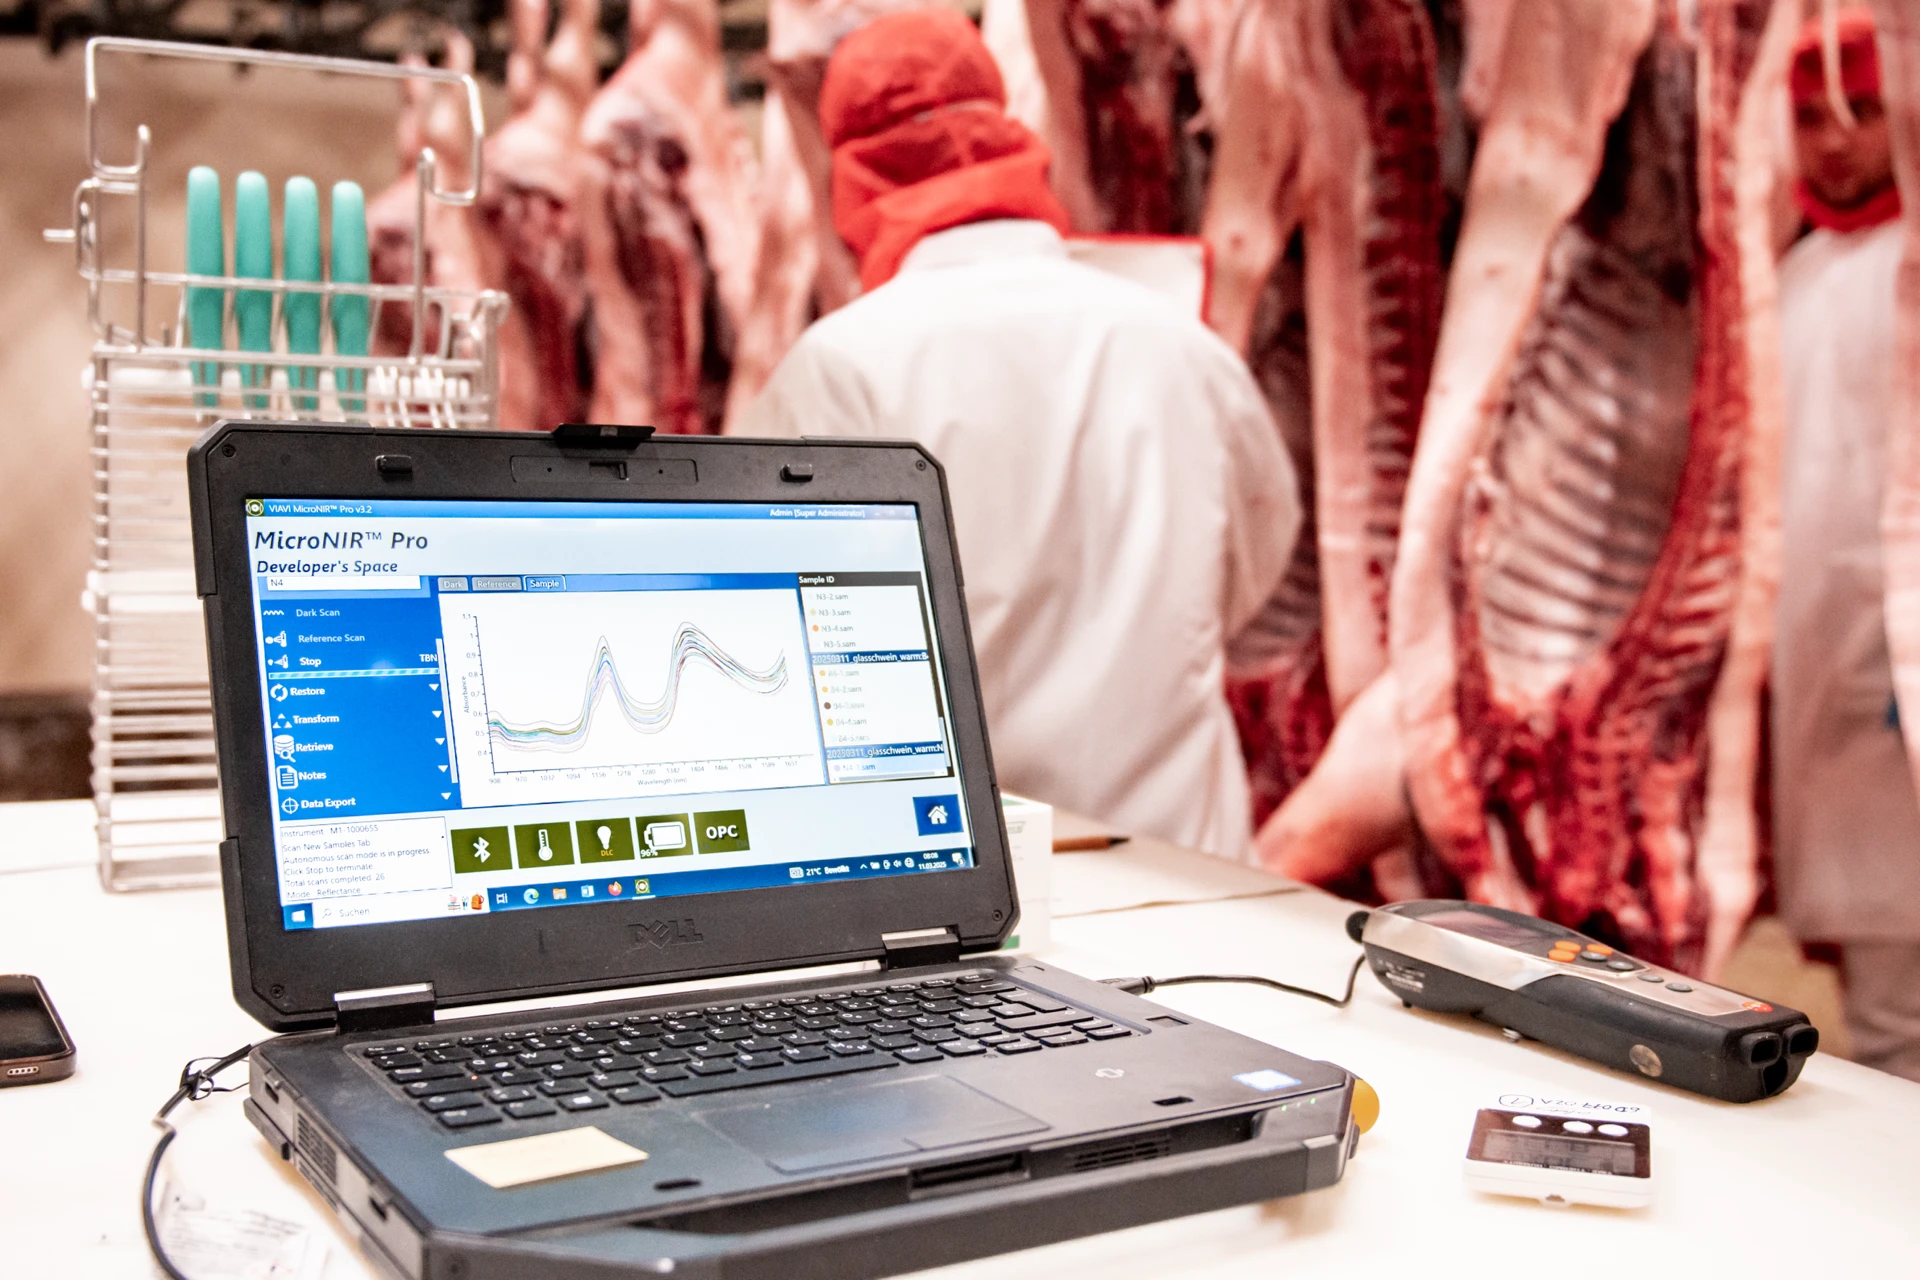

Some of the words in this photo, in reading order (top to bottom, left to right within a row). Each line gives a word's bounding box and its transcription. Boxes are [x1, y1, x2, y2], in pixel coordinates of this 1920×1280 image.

[269, 505, 291, 513] VIAVI
[340, 505, 354, 513] Pro
[356, 506, 373, 514] v3.2
[770, 509, 793, 517] Admin
[390, 531, 428, 550] Pro
[257, 560, 349, 576] Developer's
[353, 561, 398, 576] Space
[270, 579, 284, 587] N4
[443, 580, 463, 589] Dark
[477, 580, 517, 589] Reference
[530, 579, 560, 590] Sample
[798, 575, 825, 586] Sample
[826, 575, 835, 583] ID
[296, 608, 316, 617] Dark
[319, 608, 341, 617] Scan
[298, 633, 342, 643] Reference
[344, 633, 366, 642] Scan
[299, 657, 322, 667] Stop
[289, 686, 326, 696] Restore
[461, 676, 470, 714] Absorbance
[292, 714, 340, 725] Transform
[295, 741, 334, 752] Retrieve
[298, 770, 327, 781] Notes
[637, 778, 673, 786] Wavelength
[301, 800, 324, 809] Data
[325, 797, 356, 809] Export
[705, 825, 739, 839] OPC
[282, 844, 302, 852] Scan
[303, 843, 321, 851] New
[323, 841, 356, 850] Samples
[283, 854, 335, 864] Autonomous
[336, 853, 354, 861] scan
[355, 850, 379, 859] mode
[379, 850, 387, 858] is
[388, 849, 396, 857] in
[600, 849, 614, 857] DLC
[640, 849, 659, 858] 96%
[284, 868, 303, 876] Click
[306, 866, 324, 875] Stop
[285, 880, 306, 888] Total
[307, 878, 329, 887] scans
[375, 873, 386, 881] 26
[316, 887, 361, 897] Reflectance
[339, 907, 370, 917] Suchen
[627, 918, 704, 949] DELL
